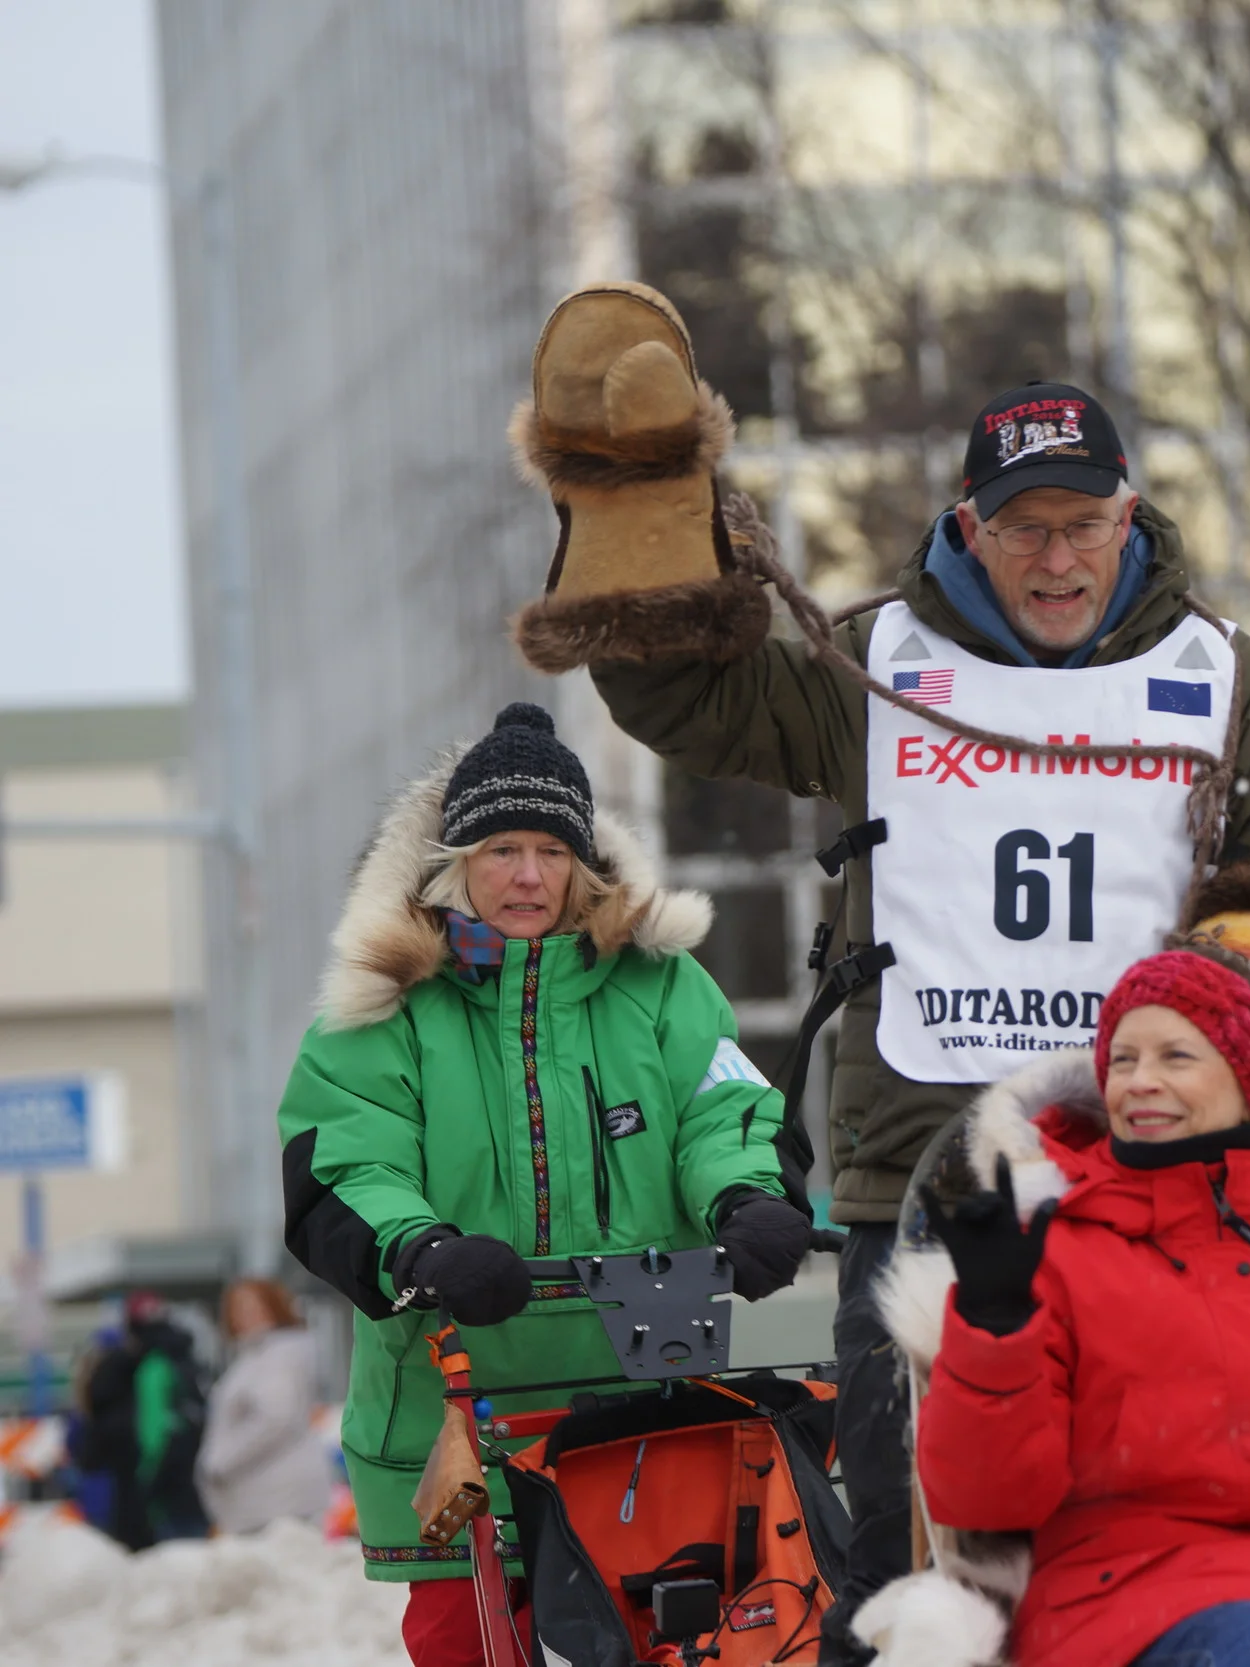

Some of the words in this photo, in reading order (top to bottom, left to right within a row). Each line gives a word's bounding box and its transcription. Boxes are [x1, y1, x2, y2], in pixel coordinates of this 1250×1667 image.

[984, 399, 1087, 435] IDITAROD
[1045, 444, 1090, 458] Alaska
[993, 828, 1095, 942] 61
[915, 987, 1106, 1029] IDITAROD
